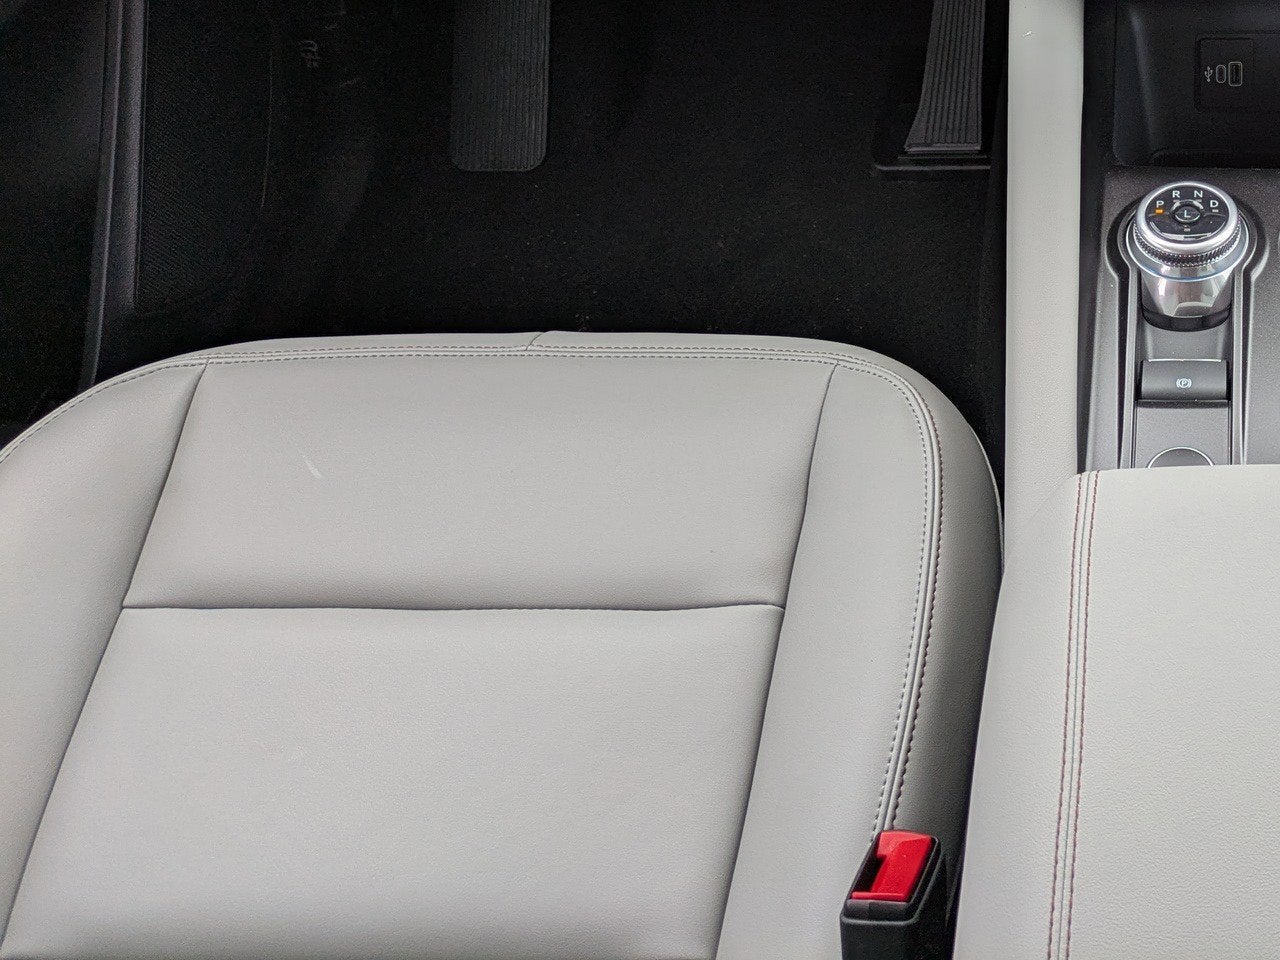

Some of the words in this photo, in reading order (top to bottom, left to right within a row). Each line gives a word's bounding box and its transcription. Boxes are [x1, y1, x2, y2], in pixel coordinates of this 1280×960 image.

[1172, 190, 1180, 198] R
[1193, 190, 1203, 198] N
[1156, 200, 1165, 208] P
[1210, 200, 1219, 208] D
[1183, 209, 1191, 218] L
